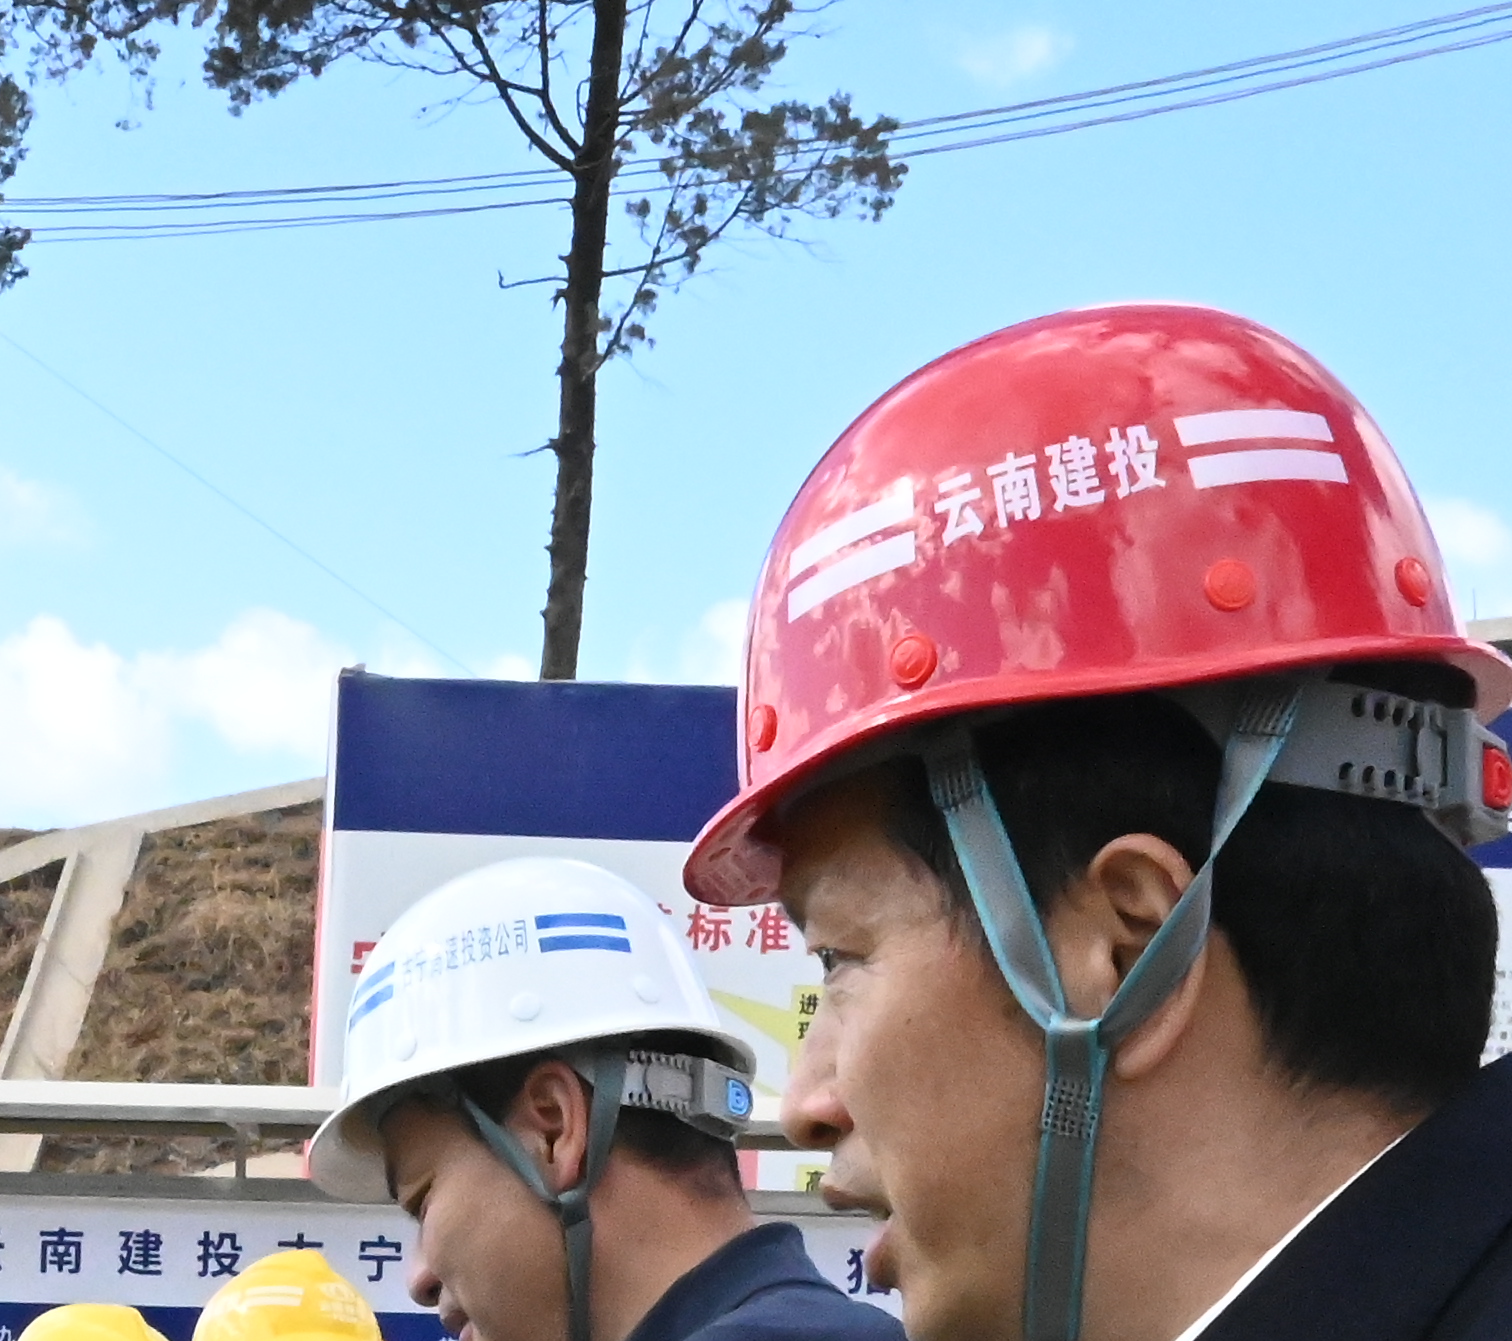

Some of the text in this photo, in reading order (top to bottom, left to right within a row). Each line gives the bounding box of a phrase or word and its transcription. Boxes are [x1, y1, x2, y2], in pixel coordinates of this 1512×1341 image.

[933, 424, 1166, 547] 云南建投
[400, 920, 529, 990] 古宁高速投资公司
